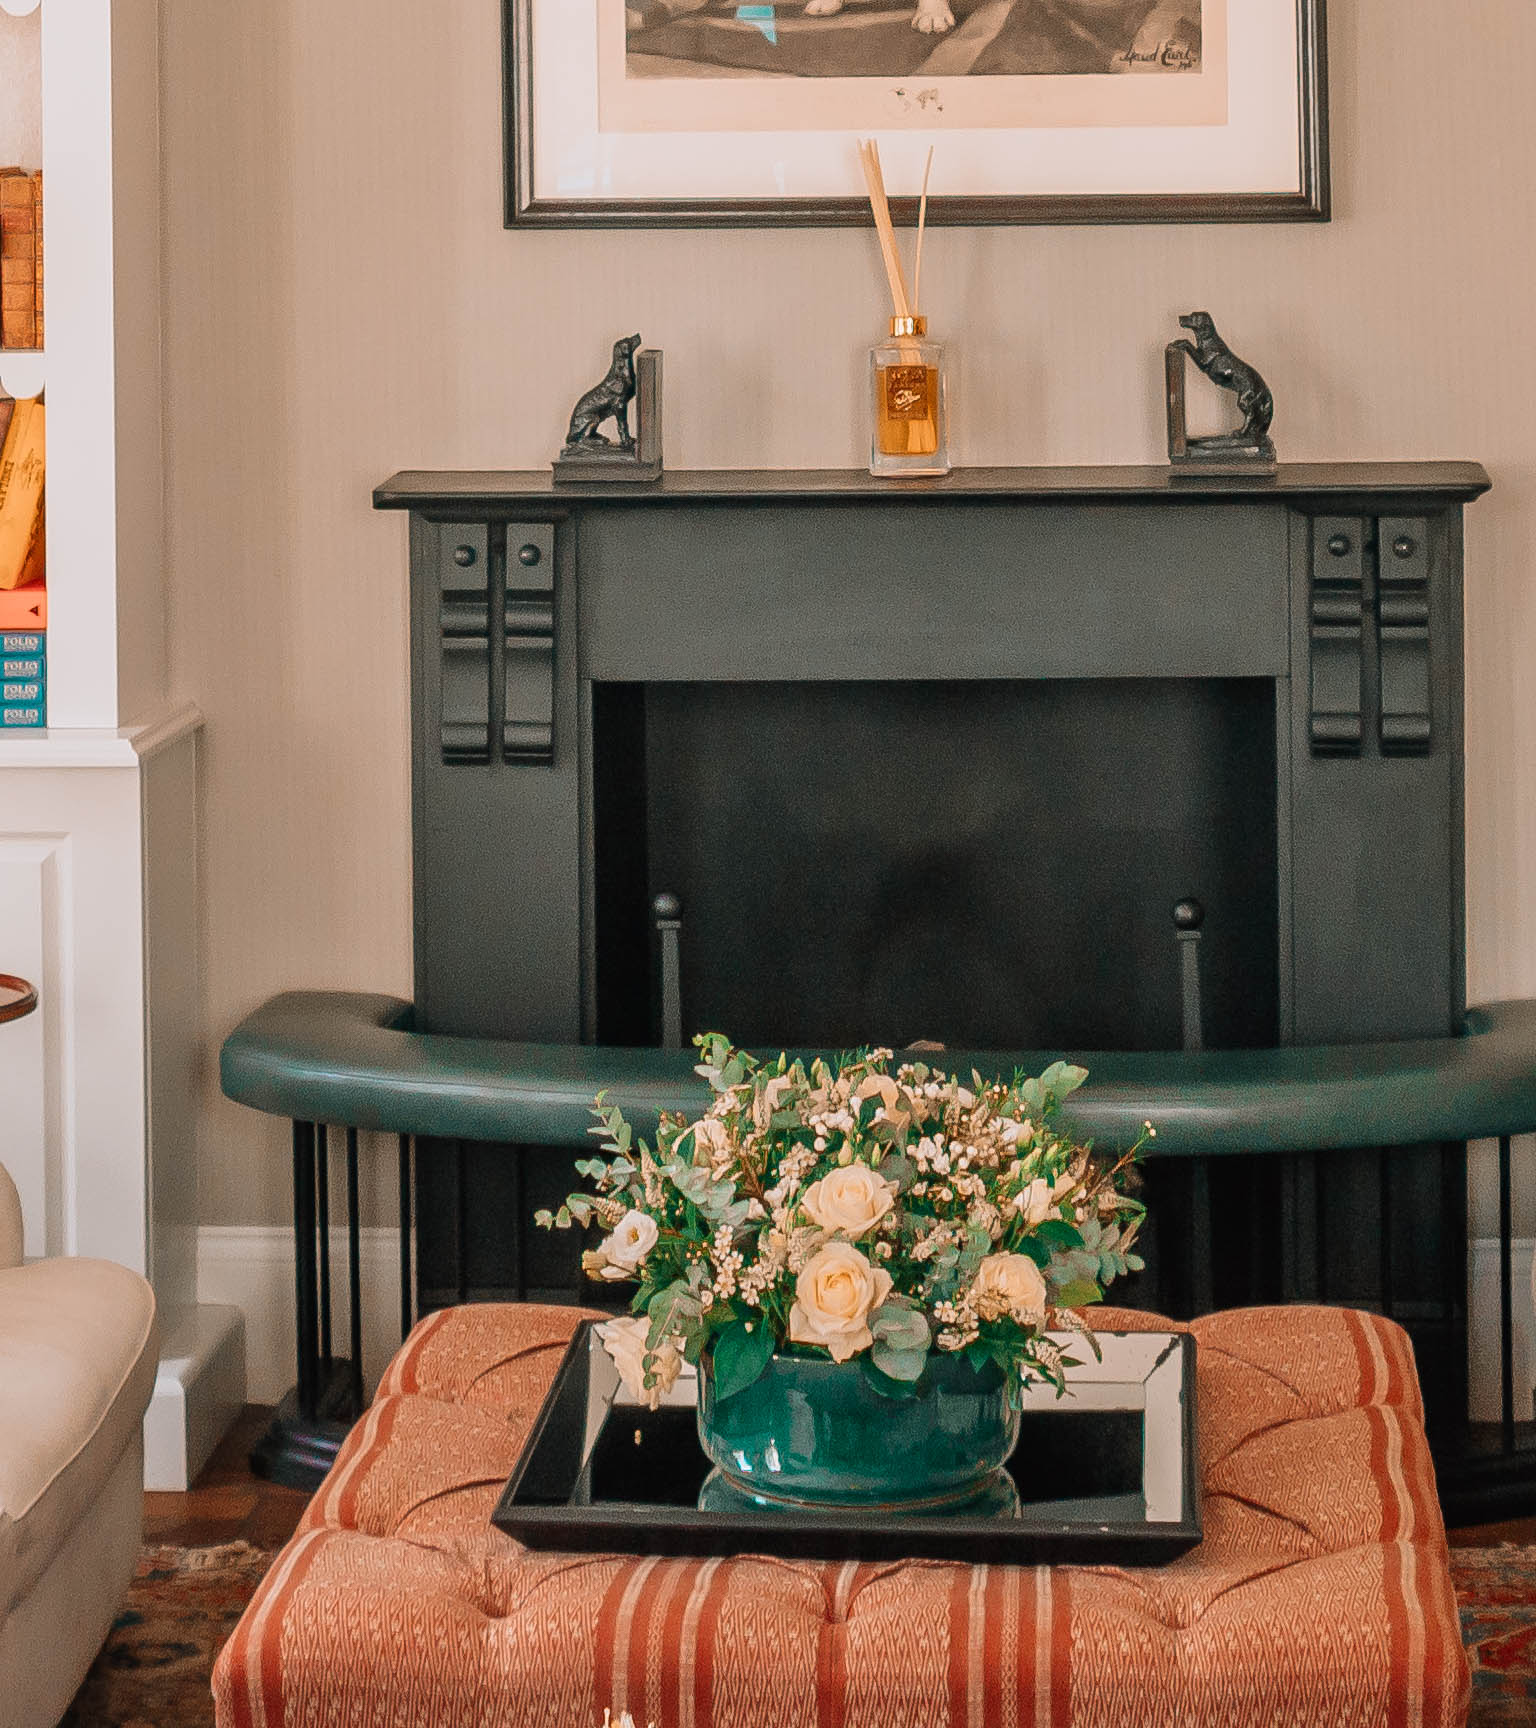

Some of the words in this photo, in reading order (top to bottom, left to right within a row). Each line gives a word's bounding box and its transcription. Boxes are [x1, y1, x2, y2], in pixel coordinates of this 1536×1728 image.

[4, 637, 39, 647] FOLIO
[4, 662, 39, 672] FOLIO
[4, 686, 39, 696] FOLIO
[4, 710, 39, 720] FOLIO
